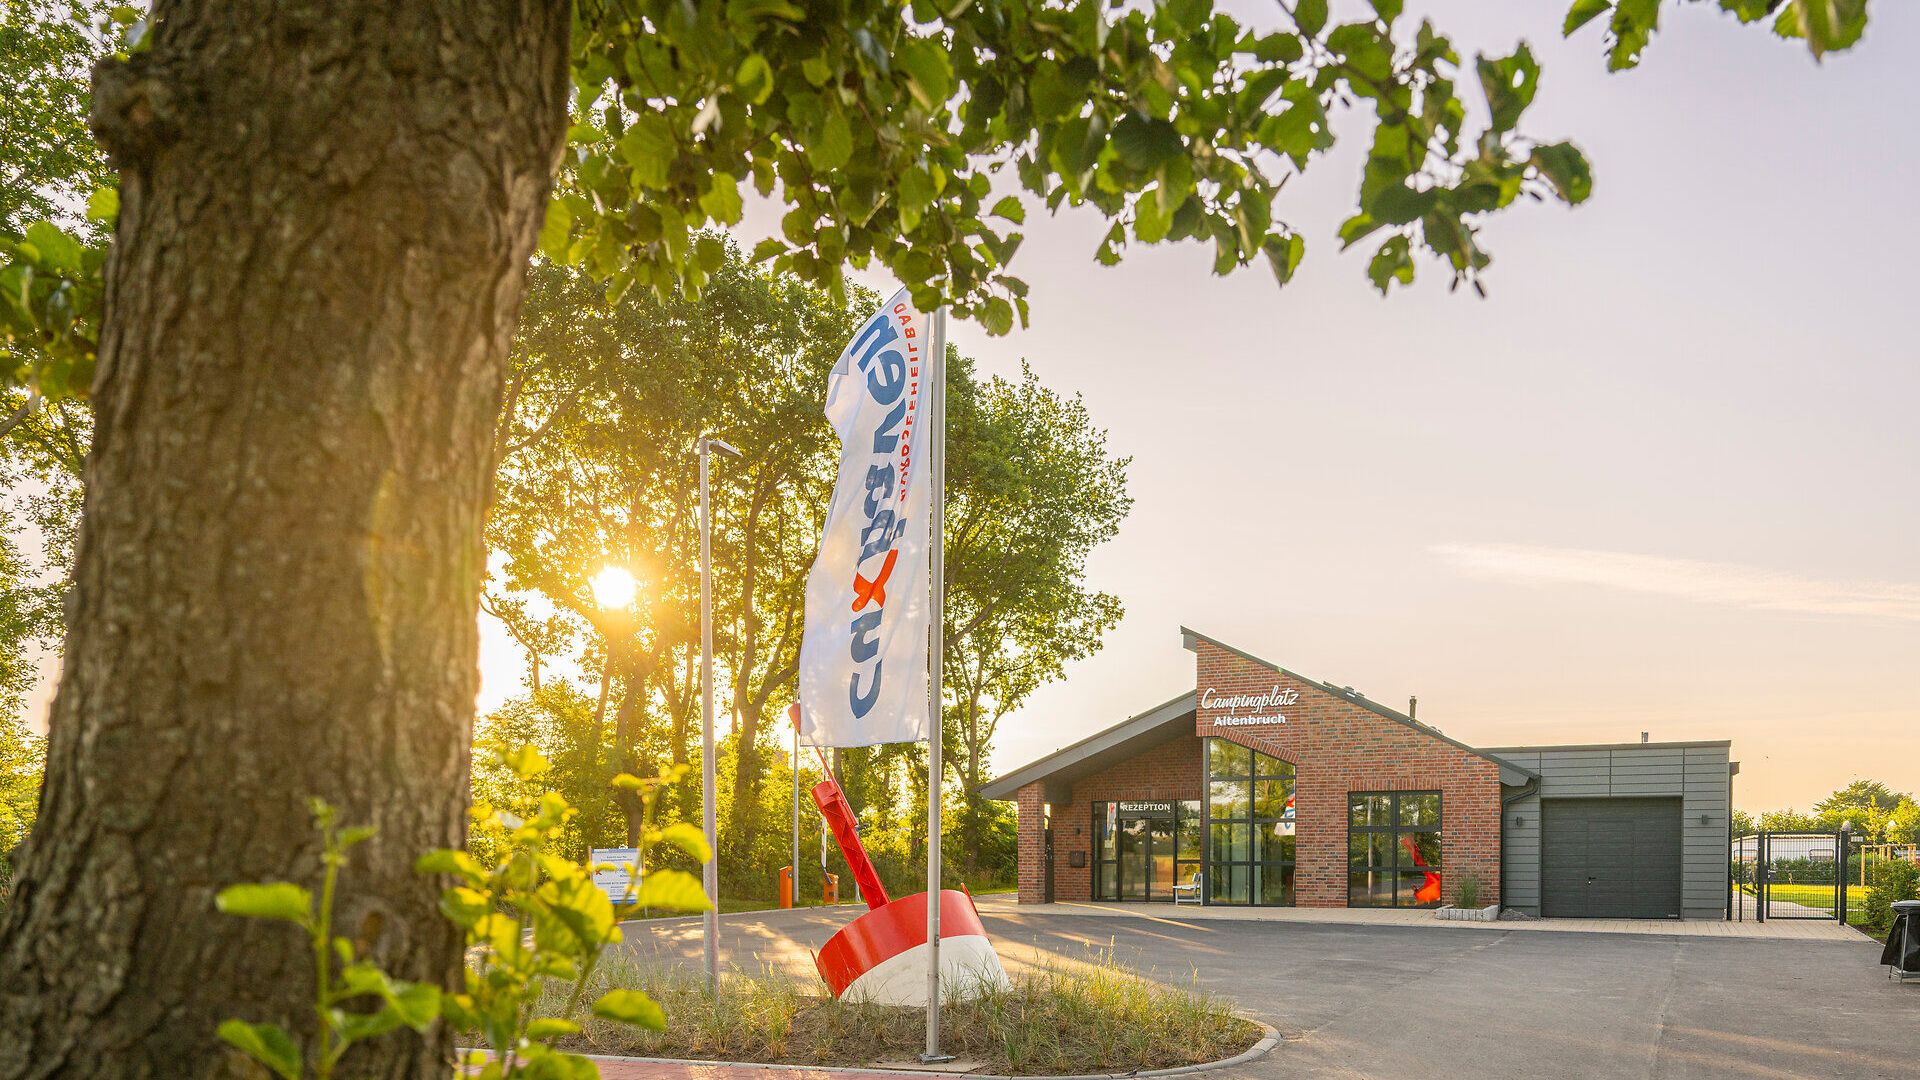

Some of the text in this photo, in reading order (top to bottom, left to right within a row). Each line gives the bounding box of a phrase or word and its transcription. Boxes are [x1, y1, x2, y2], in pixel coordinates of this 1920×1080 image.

[1201, 685, 1300, 715] Campingplatz
[1213, 714, 1286, 726] Altenbruch
[1121, 803, 1171, 811] REZEPTION
